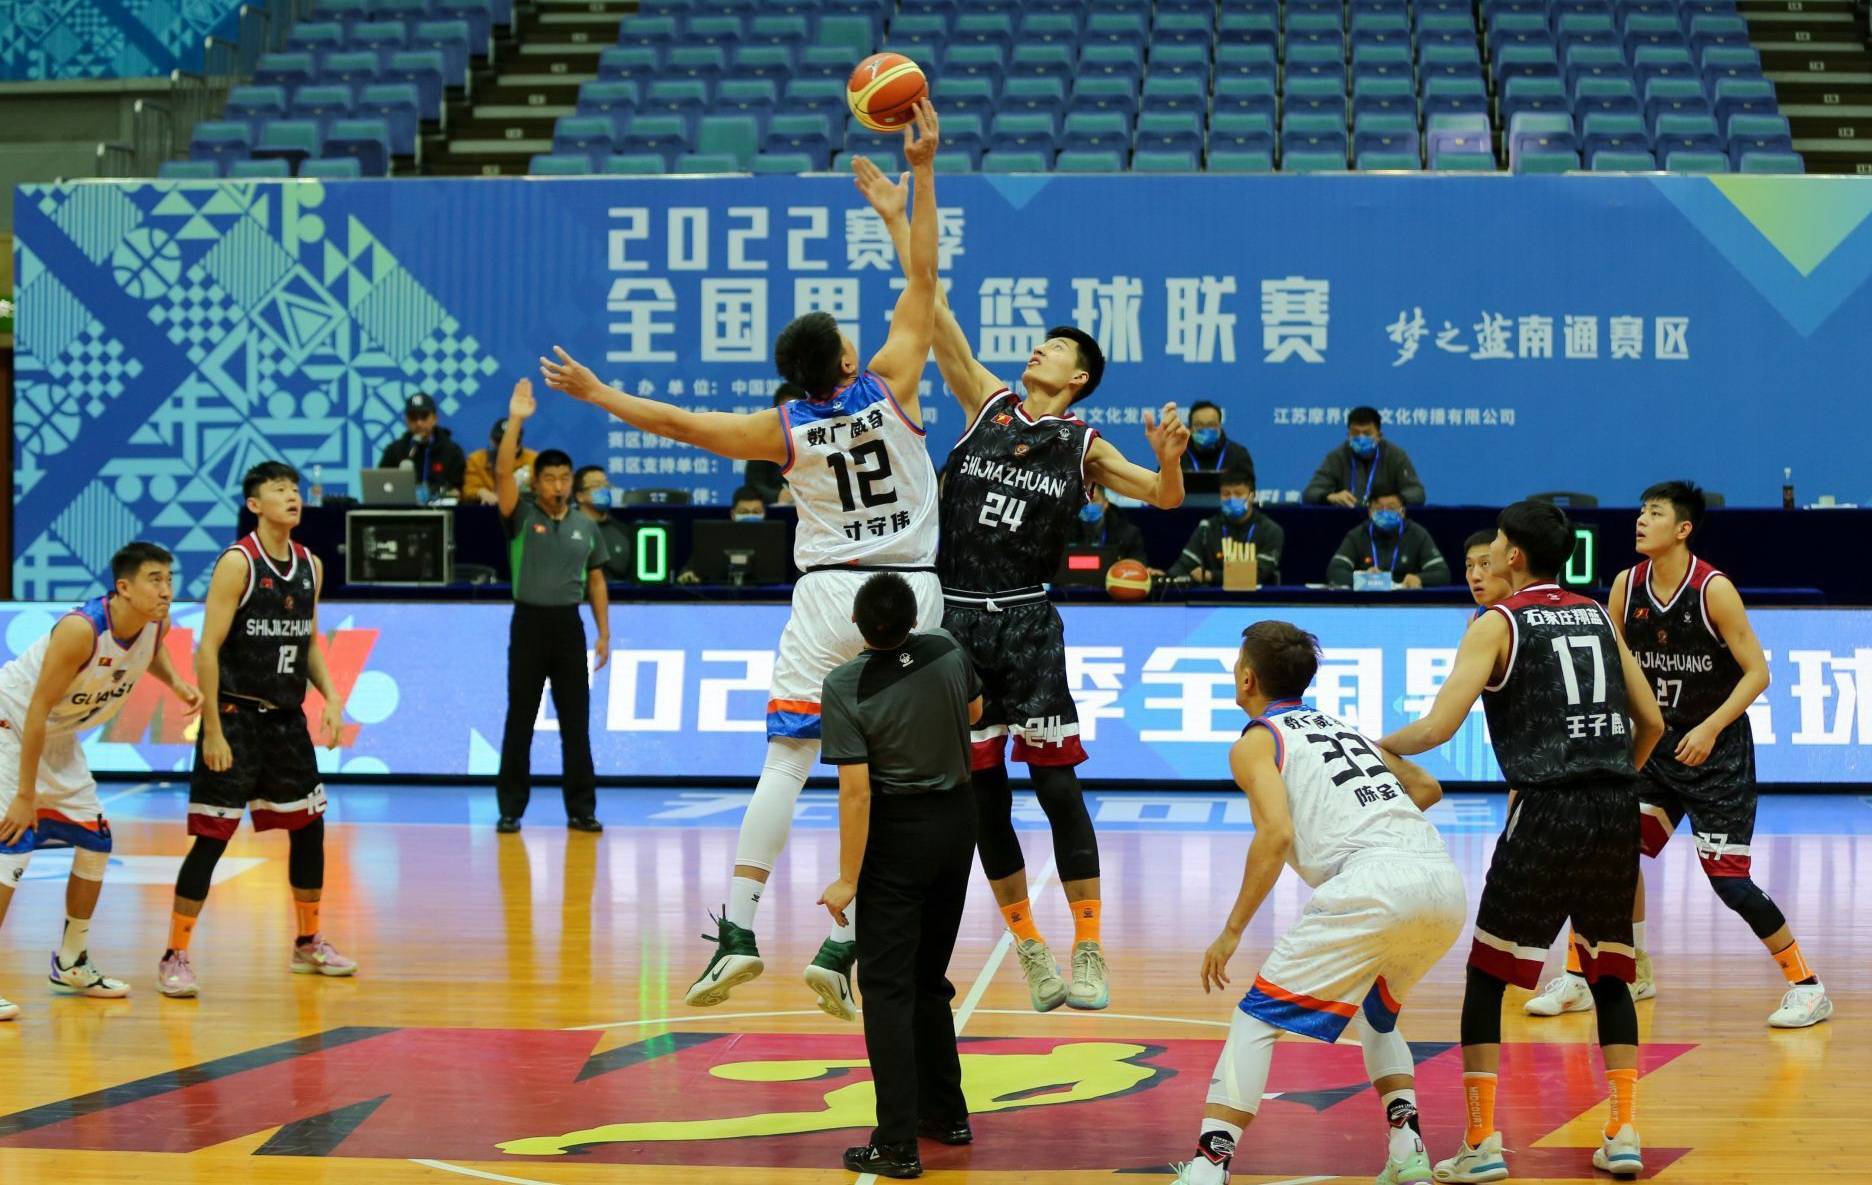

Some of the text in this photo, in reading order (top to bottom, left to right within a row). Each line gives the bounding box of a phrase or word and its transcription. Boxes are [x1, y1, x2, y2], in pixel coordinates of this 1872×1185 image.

[608, 206, 966, 272] 2022赛季
[606, 276, 1330, 364] 全国男篮球联赛
[826, 439, 898, 513] 12
[978, 491, 1027, 533] 24
[637, 527, 667, 582] 0
[277, 644, 298, 674] 12
[1551, 634, 1607, 706] 17
[1657, 677, 1682, 708] 27
[1025, 714, 1065, 749] 24
[1305, 731, 1391, 788] 33
[1353, 781, 1407, 808] 陈金
[1697, 831, 1729, 862] 27
